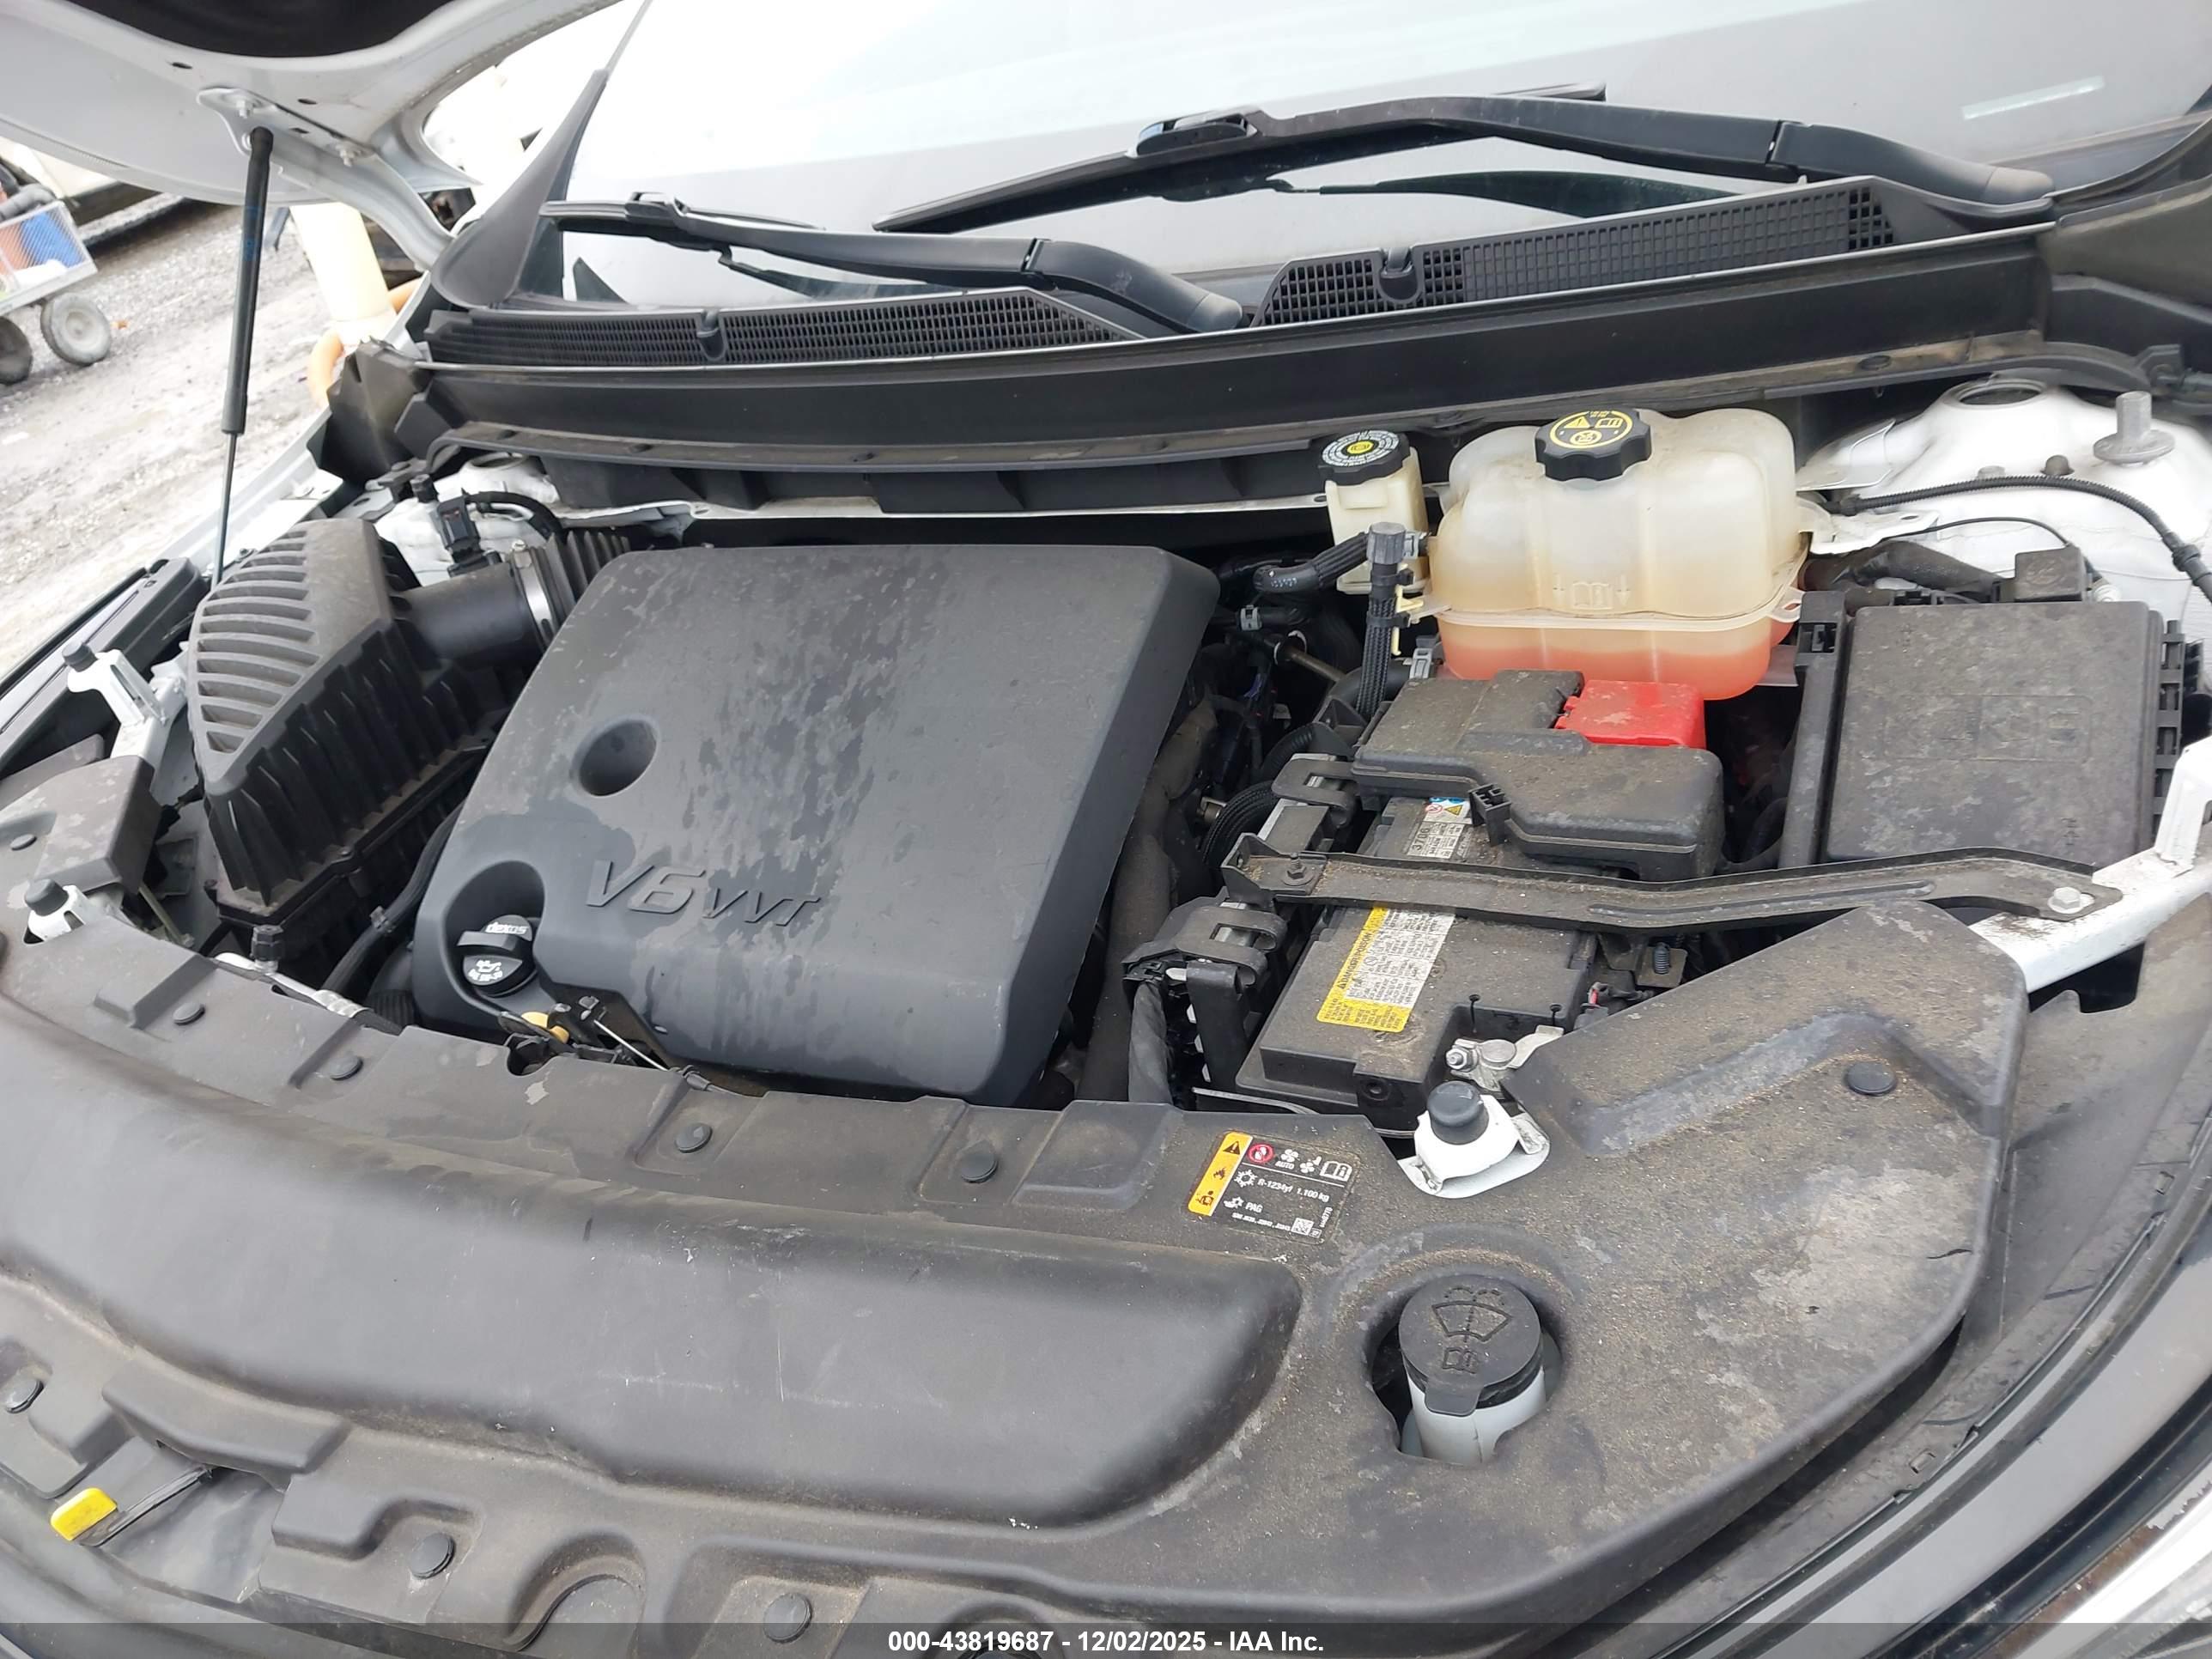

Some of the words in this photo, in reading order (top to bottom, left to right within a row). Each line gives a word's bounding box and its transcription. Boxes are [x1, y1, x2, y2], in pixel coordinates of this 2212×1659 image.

[586, 860, 706, 914] V6
[702, 888, 822, 927] VVT
[484, 921, 530, 935] dexos
[1275, 1161, 1295, 1170] AUTO
[1257, 1179, 1293, 1193] R-1234yf
[1297, 1188, 1318, 1199] 1.100
[1319, 1192, 1330, 1202] kg
[1245, 1202, 1263, 1212] PAG
